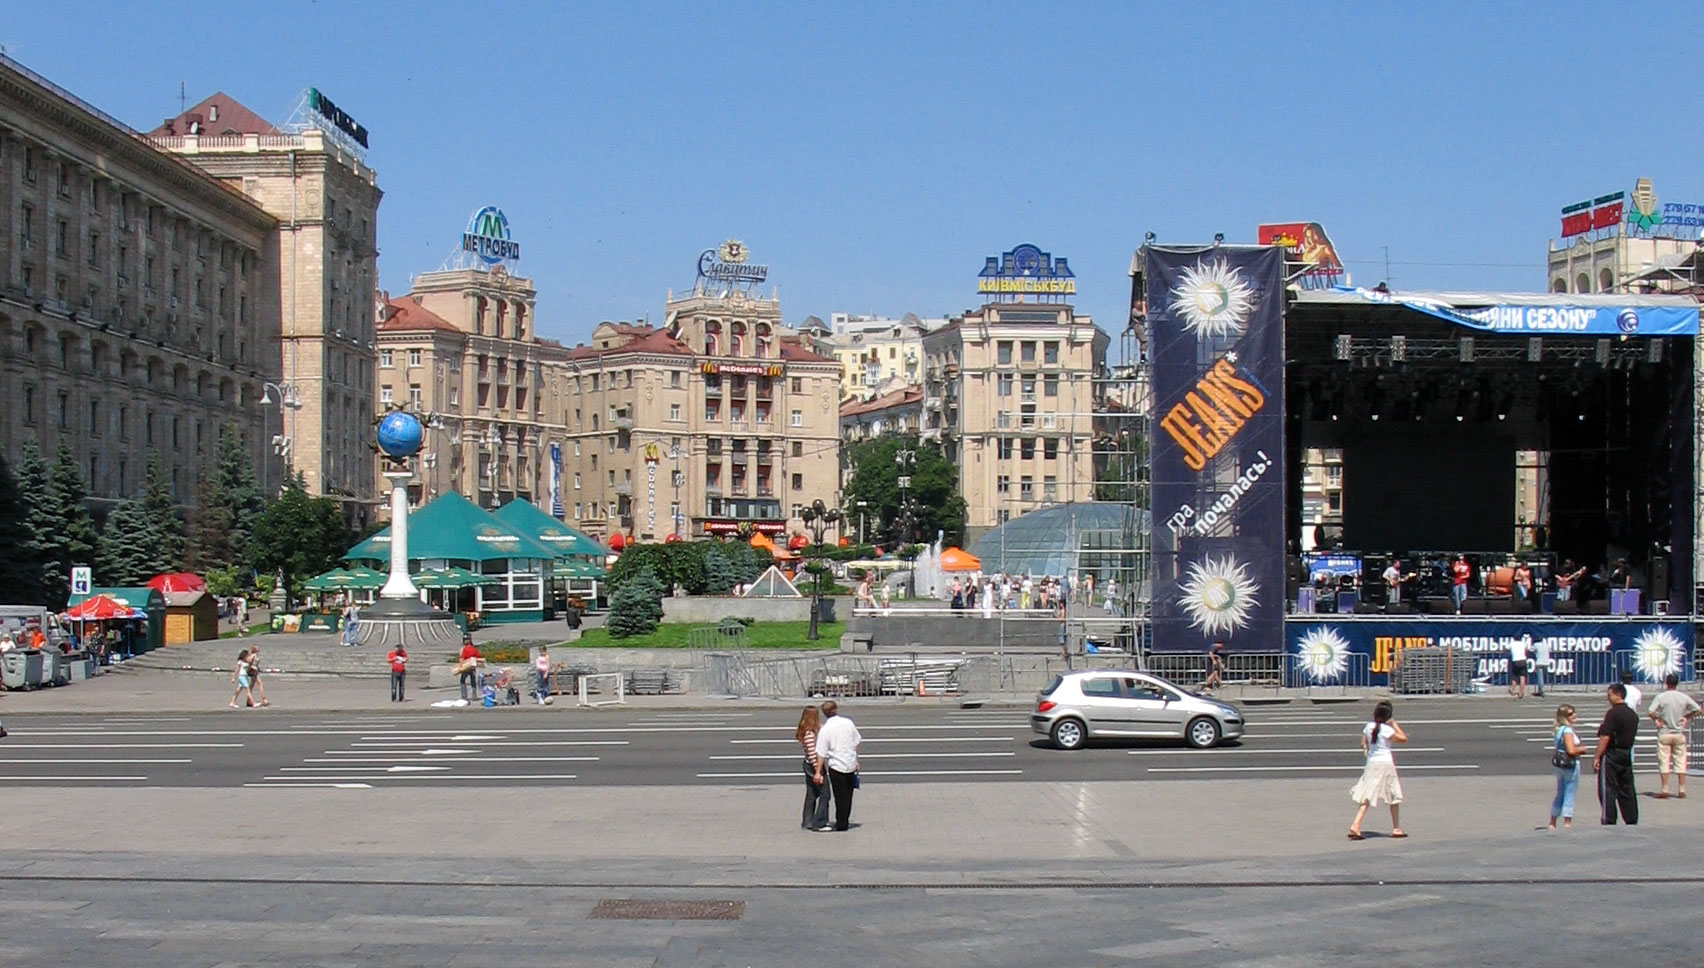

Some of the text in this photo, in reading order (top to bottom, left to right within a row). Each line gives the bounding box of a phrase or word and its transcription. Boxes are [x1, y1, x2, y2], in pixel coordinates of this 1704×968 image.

[463, 232, 520, 260] МЕТРОБУД
[979, 279, 1076, 293] КИЇВМІСЬКБУД
[1160, 358, 1265, 472] JEANS
[1194, 449, 1273, 535] почалась!
[1166, 503, 1195, 533] гра
[1439, 633, 1532, 652] МОБІЛЬНЙ
[1478, 658, 1509, 676] ДНЯ
